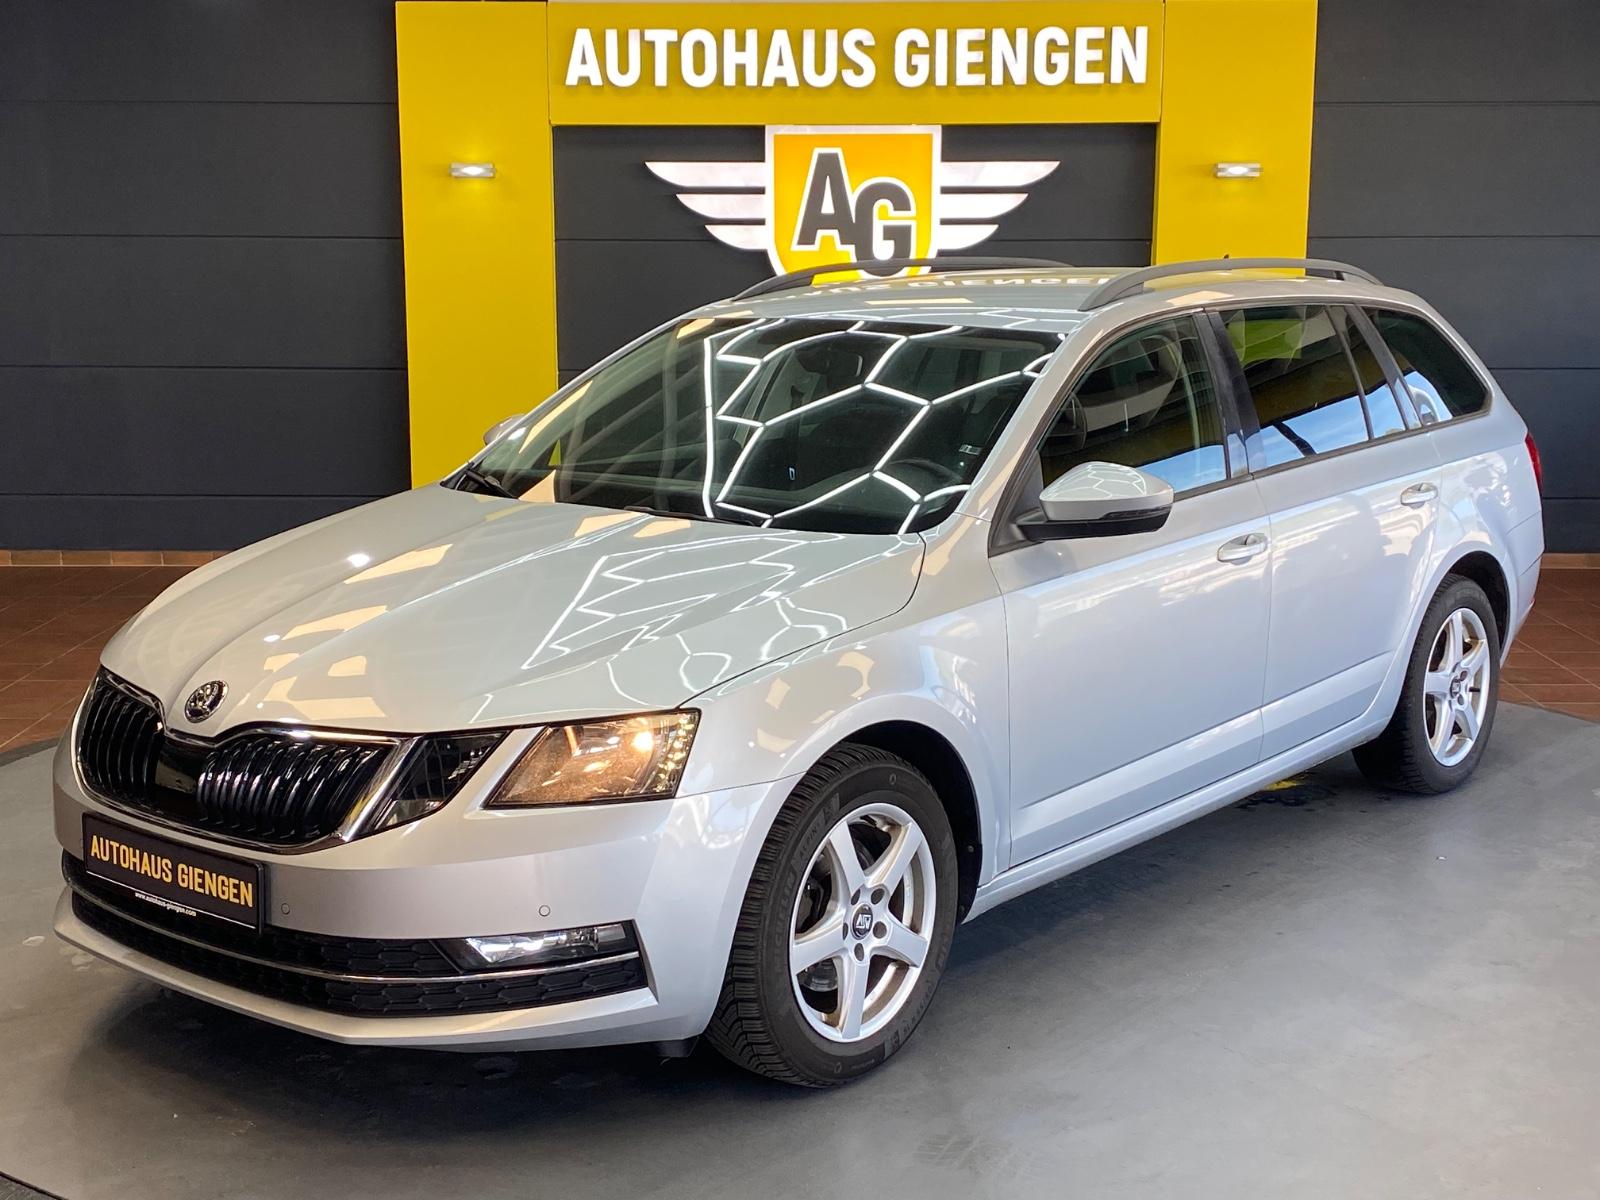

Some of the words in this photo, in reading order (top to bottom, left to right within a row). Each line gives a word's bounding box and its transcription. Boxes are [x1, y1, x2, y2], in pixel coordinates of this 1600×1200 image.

[565, 27, 877, 89] AUTOHAUS
[894, 25, 1149, 87] GIENGEN
[796, 148, 917, 277] AG
[90, 834, 173, 883] AUTOHAUS
[177, 863, 253, 908] GIENGEN
[134, 892, 197, 917] www.autohaus-giengen.com
